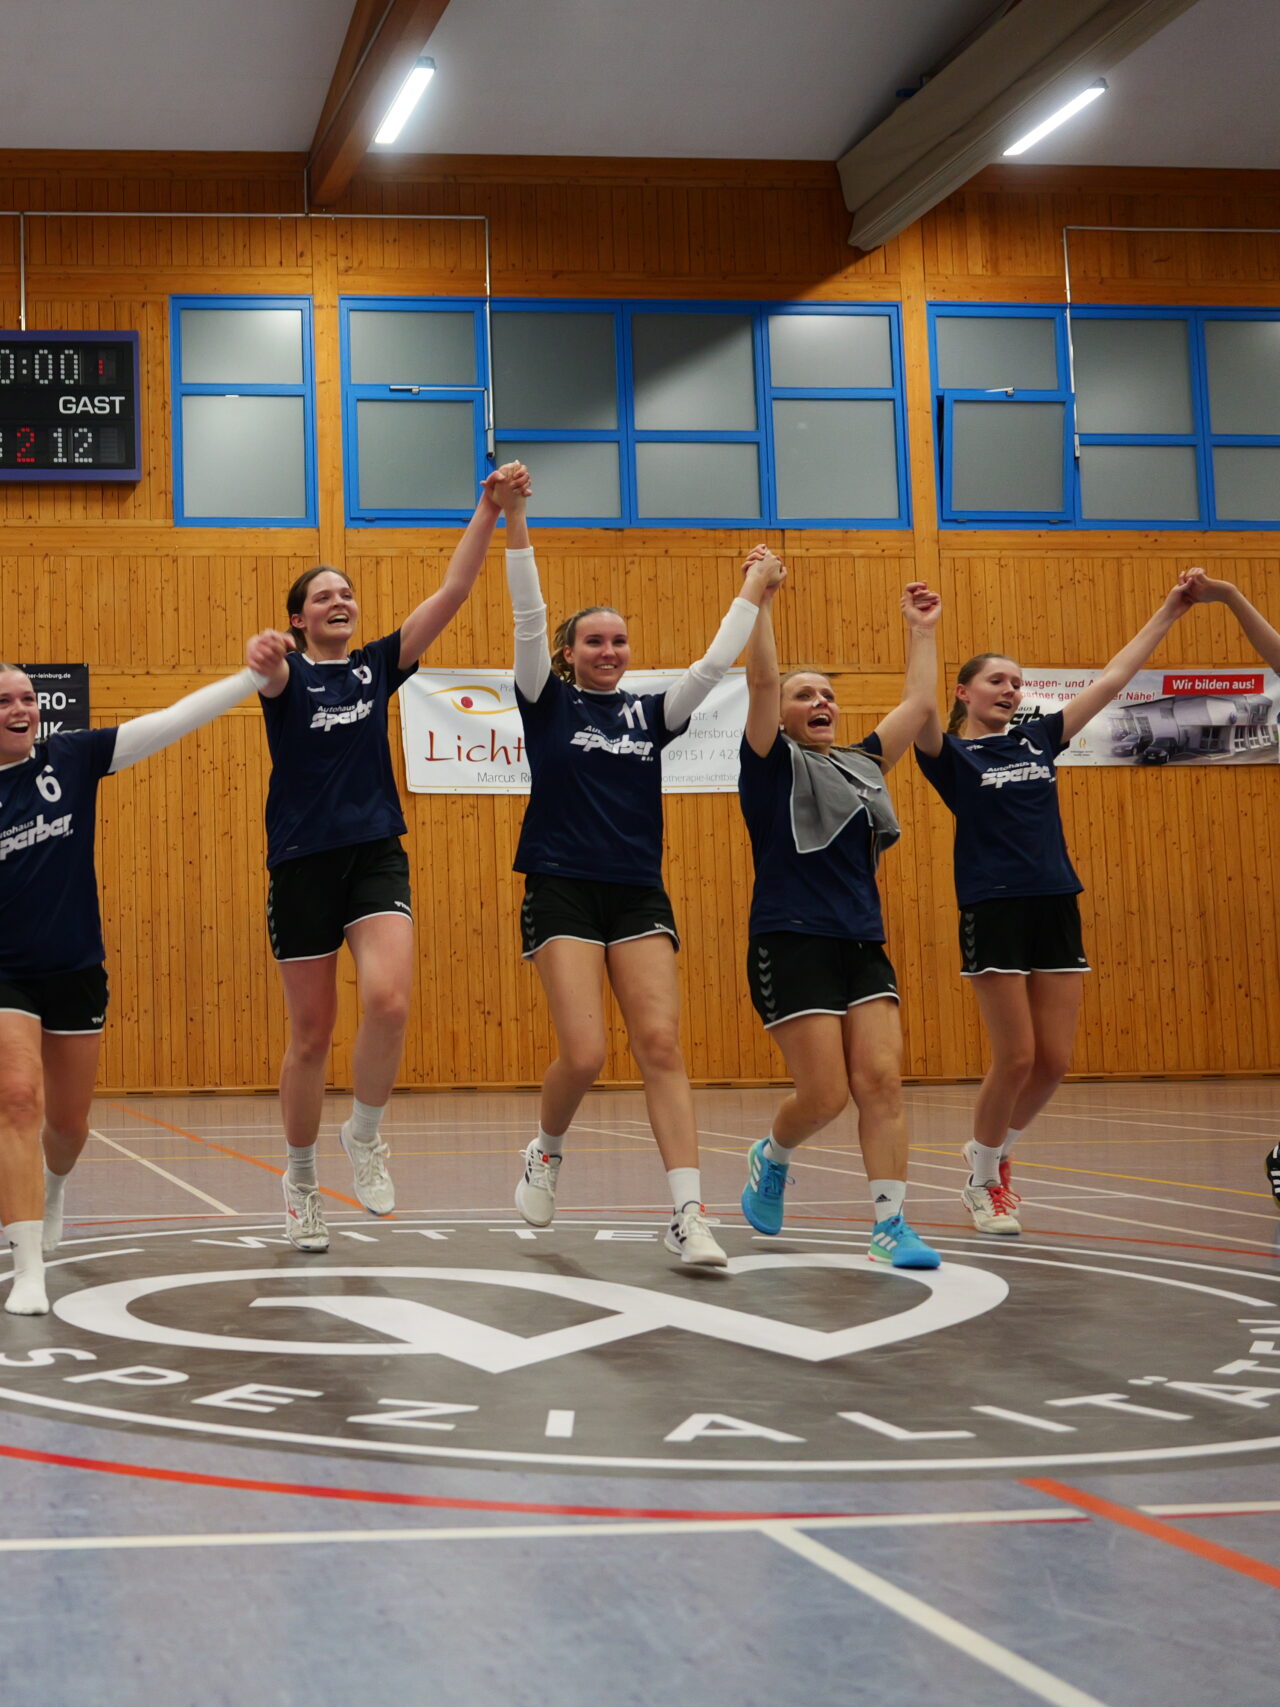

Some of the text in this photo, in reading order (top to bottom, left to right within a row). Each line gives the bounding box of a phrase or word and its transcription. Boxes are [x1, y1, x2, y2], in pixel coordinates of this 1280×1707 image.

[58, 396, 126, 415] GAST
[16, 427, 36, 463] 2
[52, 427, 93, 463] 12
[1065, 680, 1085, 688] und
[1172, 678, 1255, 690] Wir bilden aus!
[37, 691, 77, 711] RO-
[317, 704, 356, 713] Autohaus
[617, 700, 648, 730] 11
[693, 710, 719, 721] str. 4
[668, 750, 704, 761] 09151
[986, 761, 1030, 773] Autohaus
[477, 772, 516, 783] Marcus
[980, 761, 1052, 789] sperbe
[36, 765, 62, 803] 6
